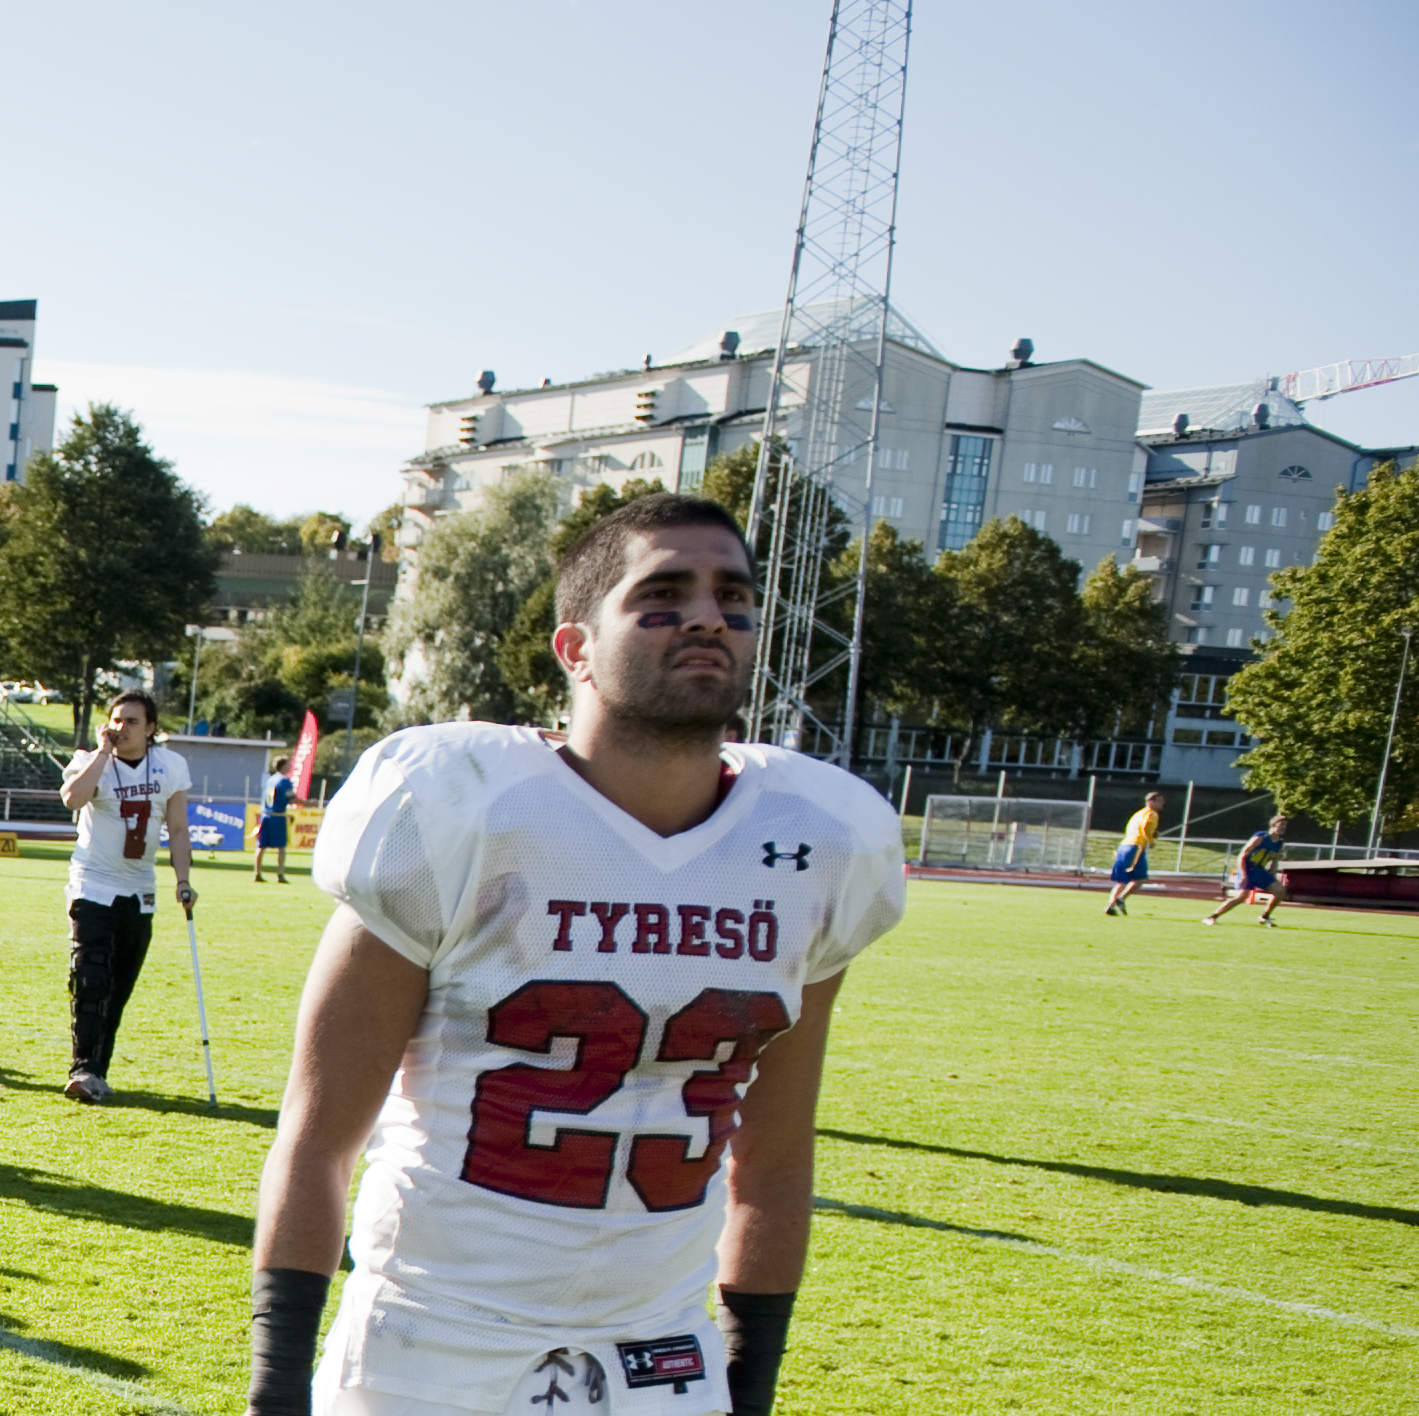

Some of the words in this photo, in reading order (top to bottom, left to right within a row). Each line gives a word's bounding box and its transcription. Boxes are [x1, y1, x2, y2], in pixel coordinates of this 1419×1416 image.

[0, 838, 16, 853] 20
[120, 800, 151, 859] 7
[548, 900, 779, 962] TYRESÖ
[459, 979, 790, 1213] 23
